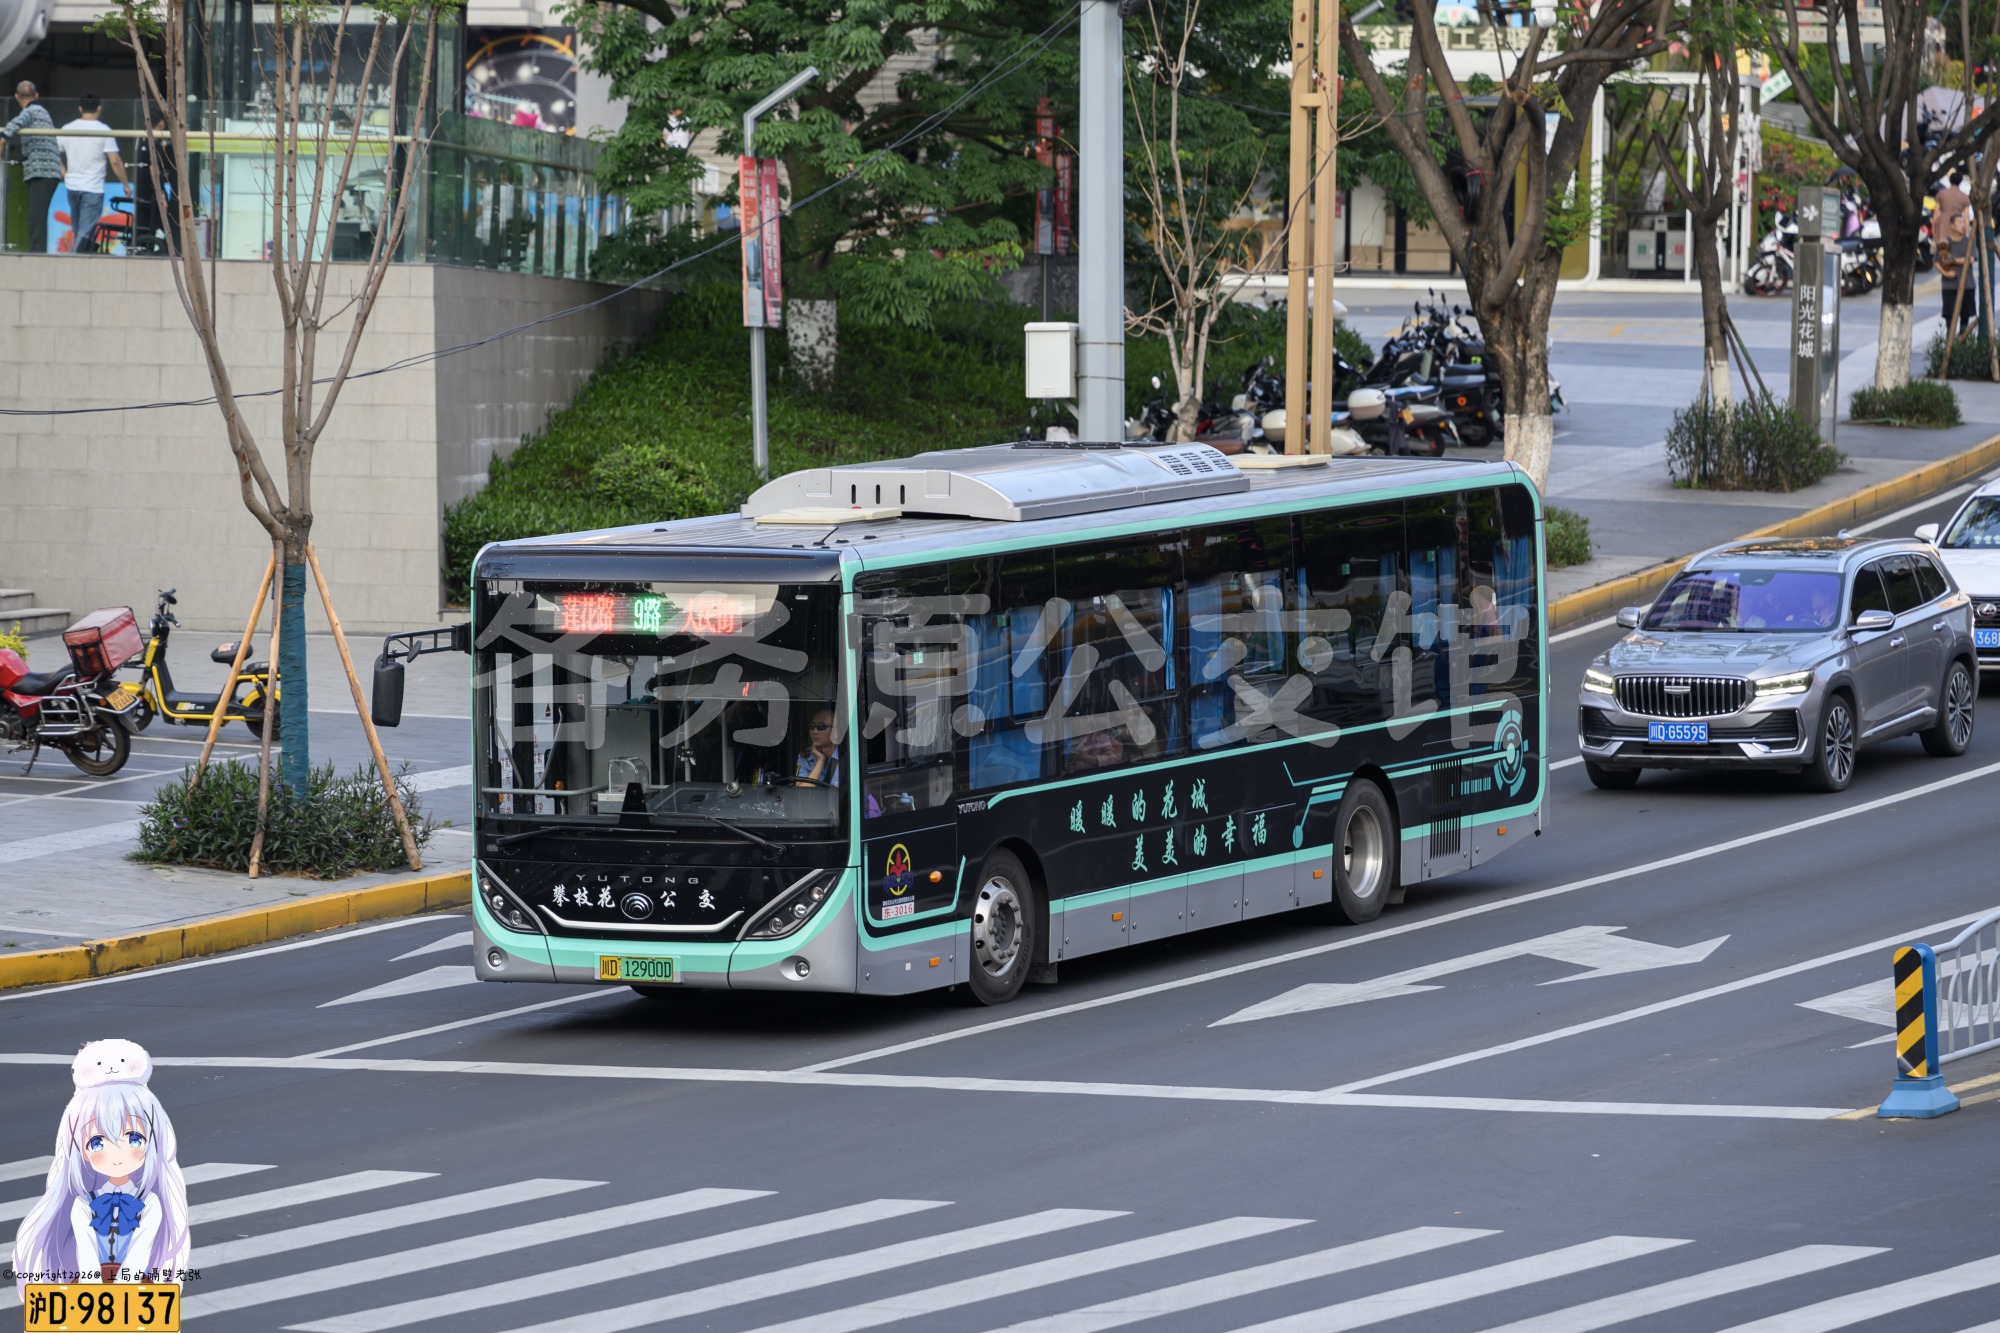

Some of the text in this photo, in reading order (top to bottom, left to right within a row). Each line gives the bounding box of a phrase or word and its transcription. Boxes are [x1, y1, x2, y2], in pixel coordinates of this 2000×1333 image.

[1797, 285, 1816, 358] 阳光花城
[562, 597, 615, 632] 莲花路
[633, 597, 662, 632] 9路
[1977, 631, 2000, 645] 368
[958, 801, 986, 814] YUTONG
[1070, 778, 1208, 834] 暖暖的花城
[1131, 812, 1267, 872] 美美的幸福
[576, 874, 699, 885] YUTONG
[552, 883, 716, 911] 攀枝花 公交
[884, 904, 913, 918] 东-3016
